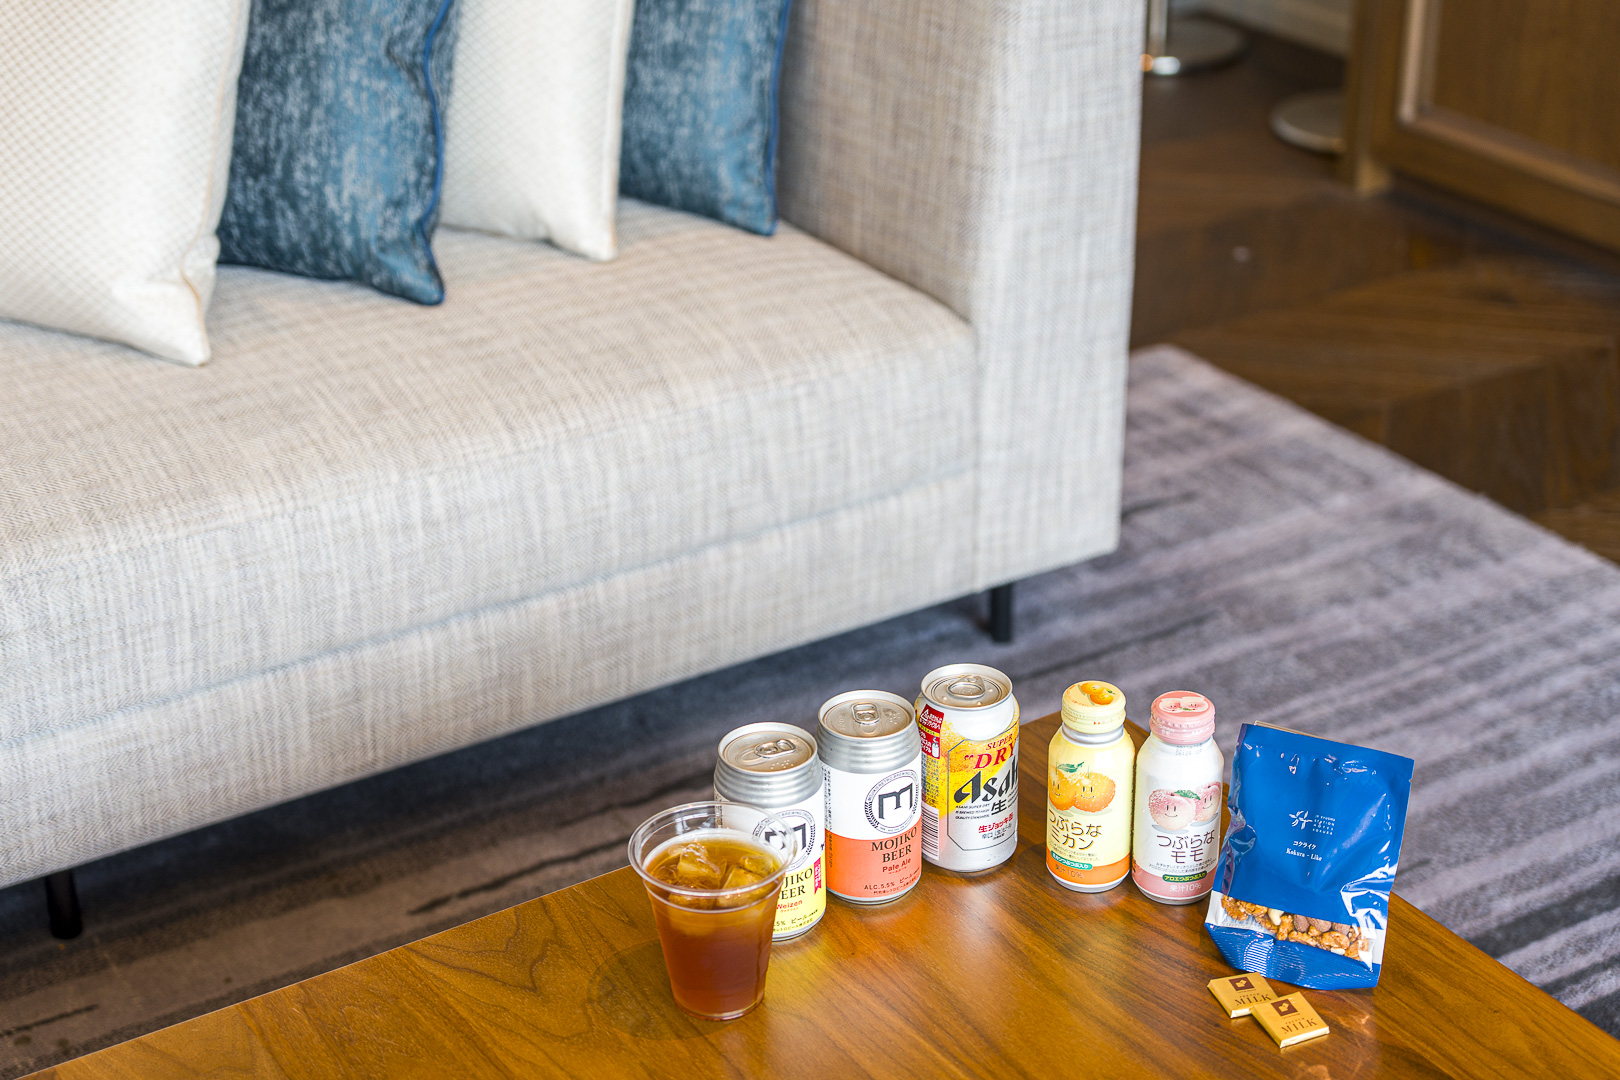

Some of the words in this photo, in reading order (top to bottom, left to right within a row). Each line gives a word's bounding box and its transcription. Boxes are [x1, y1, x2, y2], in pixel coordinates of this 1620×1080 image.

[985, 733, 1013, 751] SUPER
[990, 799, 1008, 816] 生
[1048, 808, 1103, 838] つぶらな
[871, 826, 917, 852] MOJIKO
[1051, 824, 1095, 851] ミカン
[1156, 829, 1215, 850] つぶらな
[882, 844, 911, 863] BEER
[1170, 848, 1204, 864] モモ
[1310, 853, 1322, 861] Like
[882, 864, 899, 872] Pale
[901, 858, 911, 867] Ale
[783, 867, 813, 889] JIKO
[778, 884, 806, 900] EER
[1169, 882, 1202, 893] 果汁10%
[1234, 993, 1272, 1006] MILK
[1281, 1018, 1317, 1035] MILK
